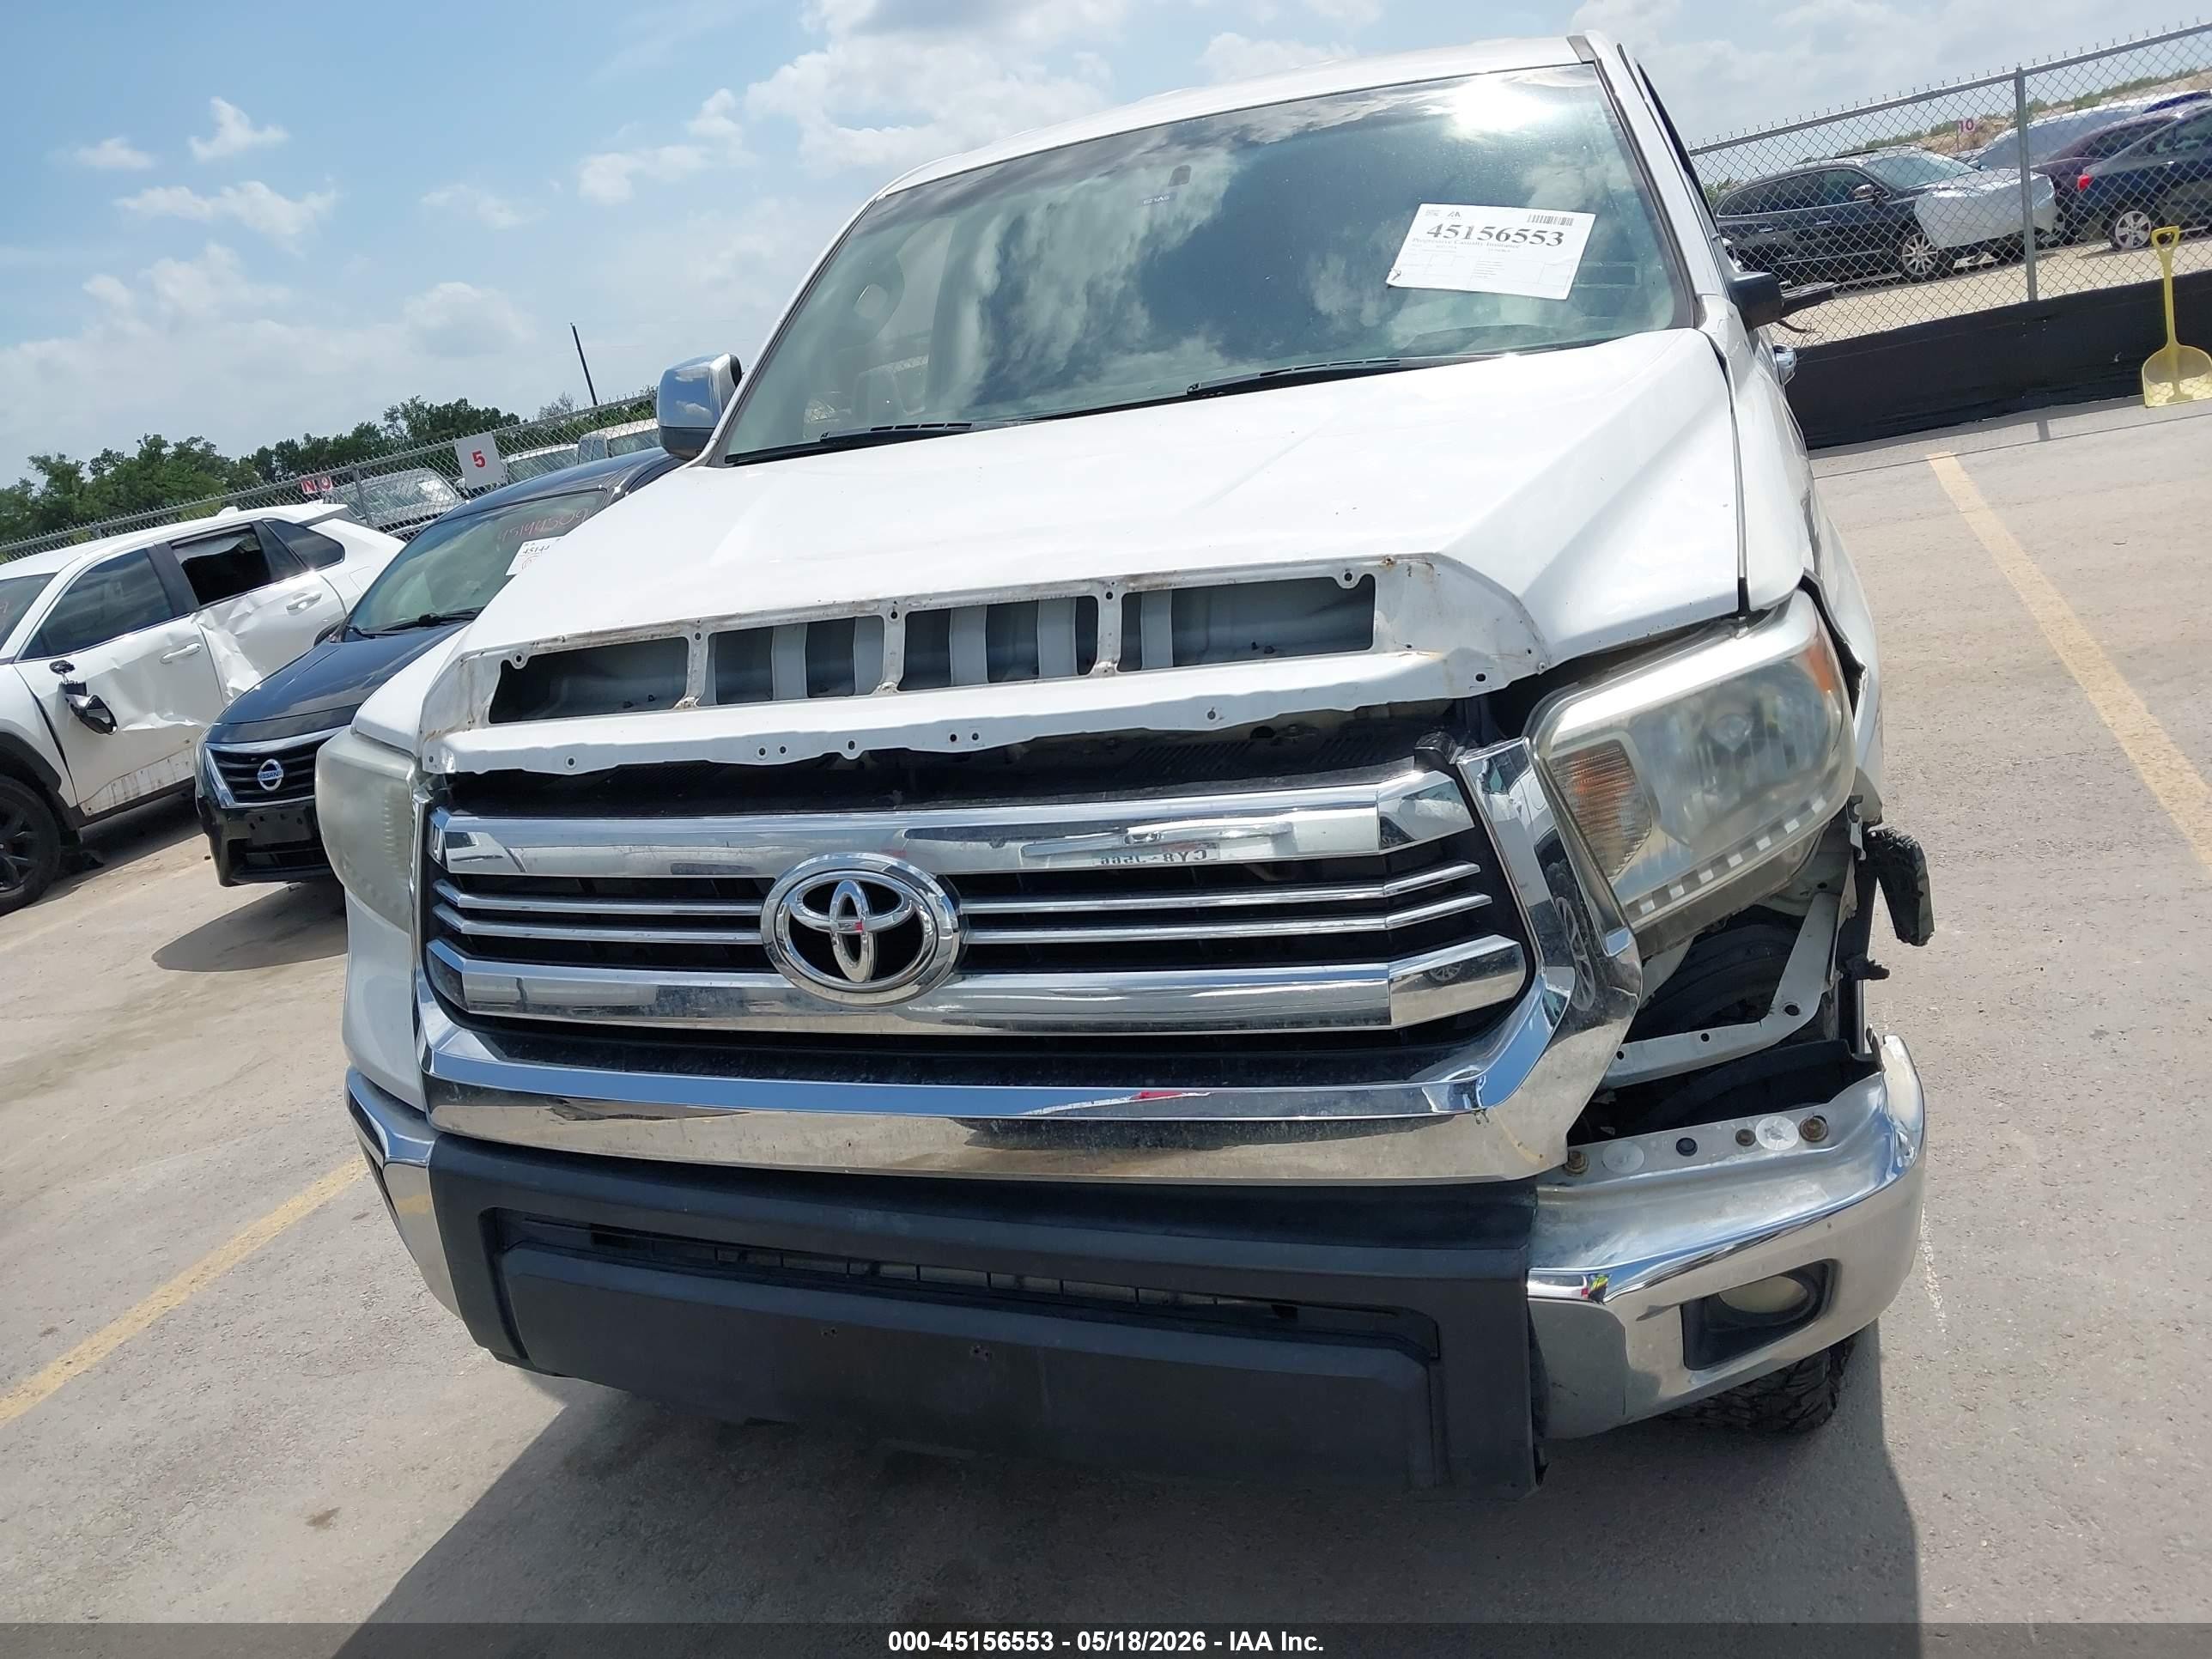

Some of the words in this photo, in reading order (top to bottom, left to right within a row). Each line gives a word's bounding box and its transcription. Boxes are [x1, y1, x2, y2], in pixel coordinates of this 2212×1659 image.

[1958, 118, 1974, 132] 10
[1426, 223, 1565, 246] 45156553
[472, 450, 486, 468] 5
